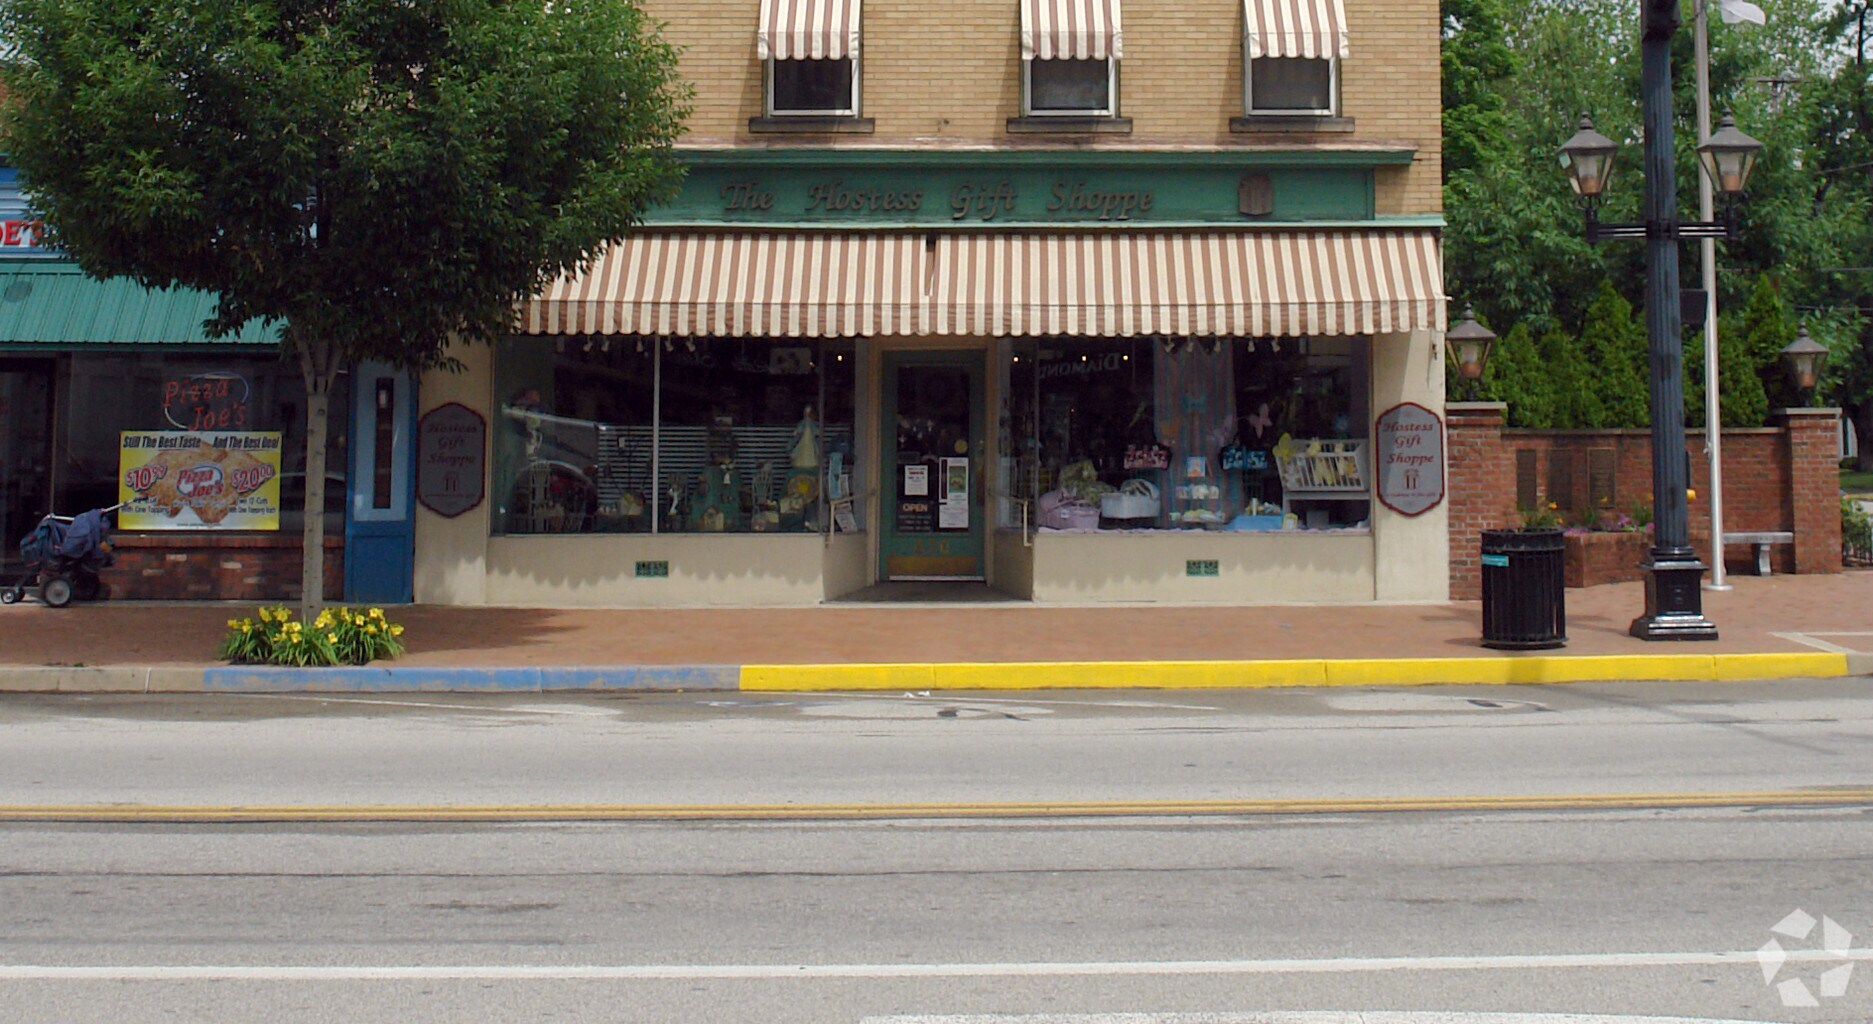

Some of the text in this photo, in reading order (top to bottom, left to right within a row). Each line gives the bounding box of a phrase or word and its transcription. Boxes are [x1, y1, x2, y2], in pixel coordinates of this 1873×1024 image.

[720, 180, 1153, 220] The Hostess Gift Shoppe
[0, 221, 43, 246] E'S
[163, 379, 229, 407] Pizza
[189, 402, 246, 430] Joe's
[1384, 423, 1433, 432] Hostess
[123, 436, 201, 449] Still The Best Taste
[213, 436, 229, 449] And
[229, 436, 243, 449] The
[244, 436, 261, 449] Best
[1394, 435, 1422, 449] Gift
[1387, 452, 1434, 467] Shoppe
[177, 469, 214, 486] Pizza
[188, 479, 224, 497] Joe's
[904, 503, 928, 512] OPEN
